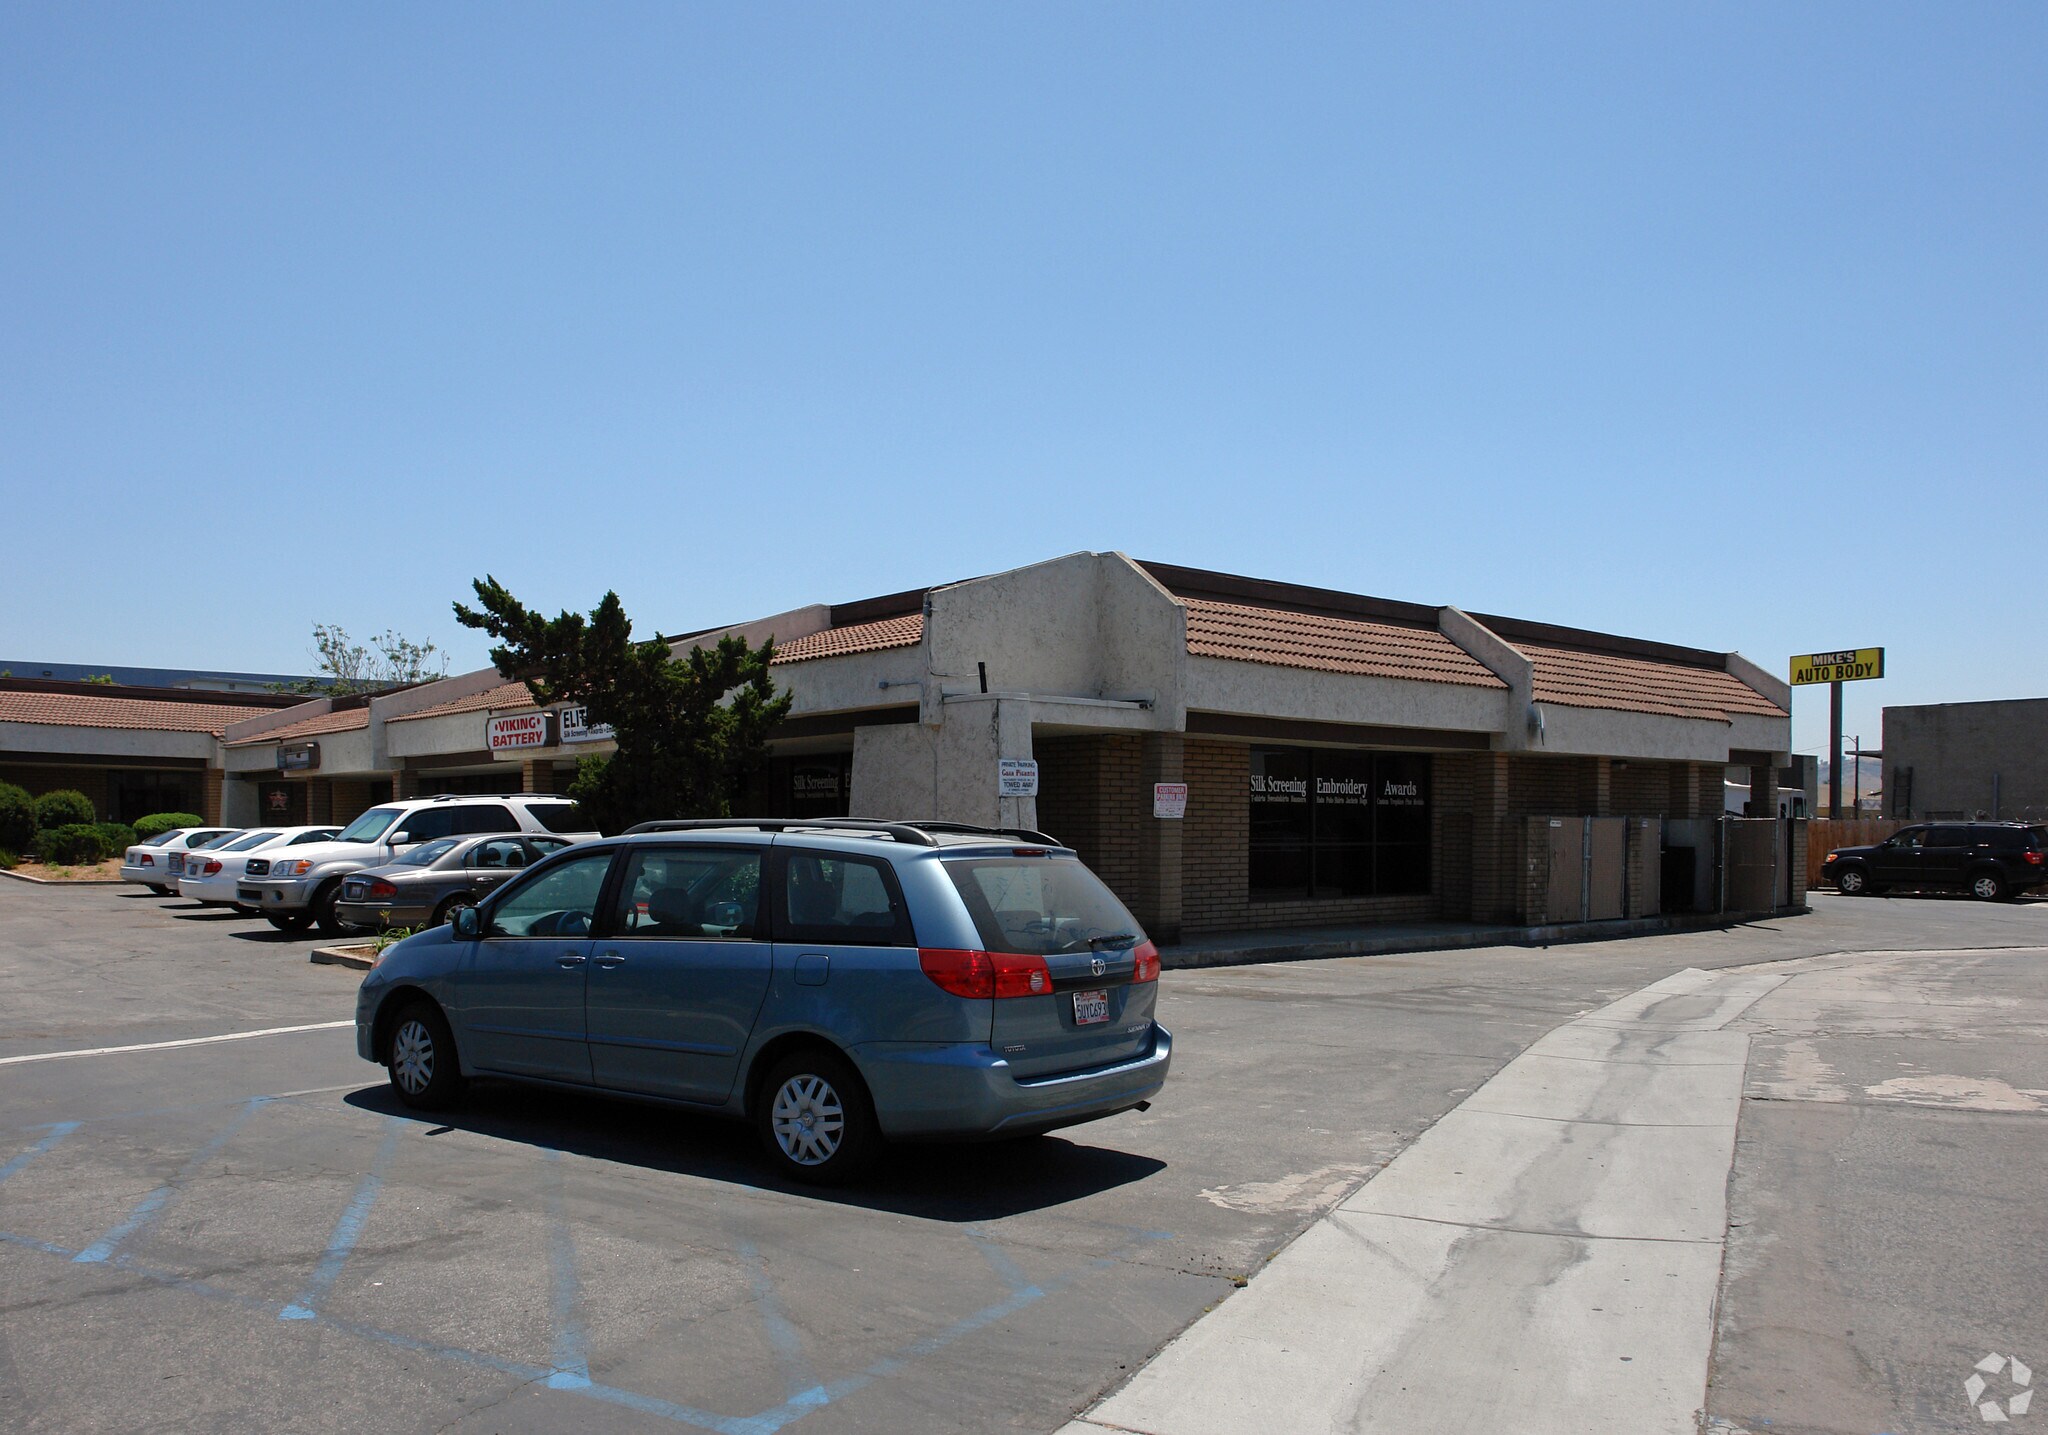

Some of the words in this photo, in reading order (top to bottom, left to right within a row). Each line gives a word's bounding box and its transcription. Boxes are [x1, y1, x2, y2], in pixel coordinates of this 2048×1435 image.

[1812, 651, 1855, 667] MIKE'S
[1796, 666, 1830, 683] AUTO
[1835, 662, 1873, 680] BODY
[493, 731, 543, 747] BATTERY
[793, 774, 806, 790] Silk
[806, 773, 839, 793] Screening
[1250, 775, 1266, 792] Silk
[1267, 775, 1307, 797] Screening
[1316, 778, 1368, 799] Embroidery
[1384, 780, 1417, 797] Awards
